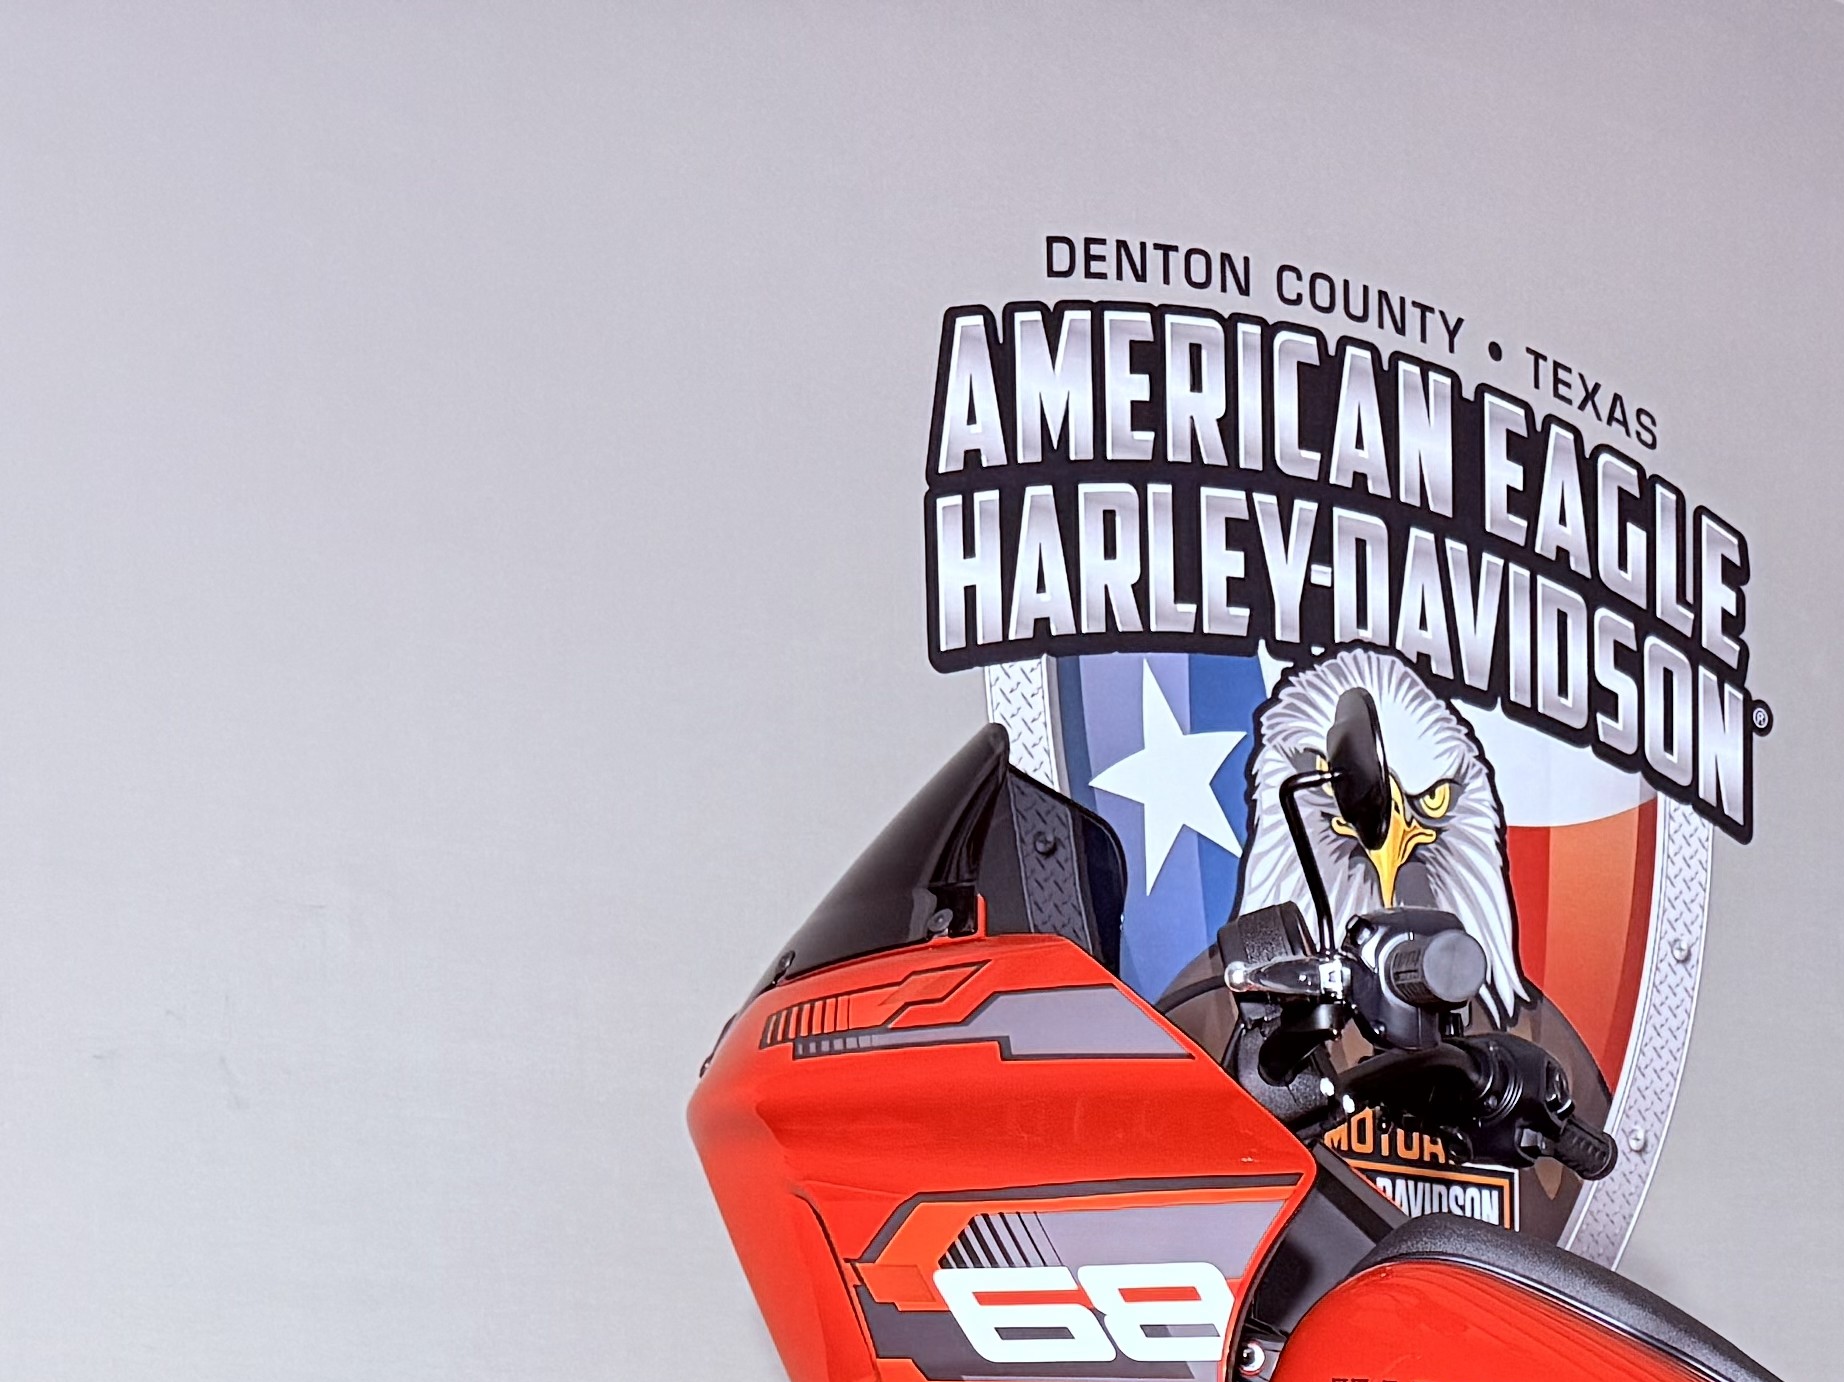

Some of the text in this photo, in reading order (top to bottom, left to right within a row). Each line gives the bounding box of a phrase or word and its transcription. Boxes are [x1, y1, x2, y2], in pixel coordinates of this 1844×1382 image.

[1045, 236, 1659, 450] DENTON COUNTY TEXAS
[937, 308, 1746, 667] AMERICAN EAGLE
[935, 484, 1749, 825] HARLEY-DAVIDSON
[933, 1262, 1236, 1362] 68
